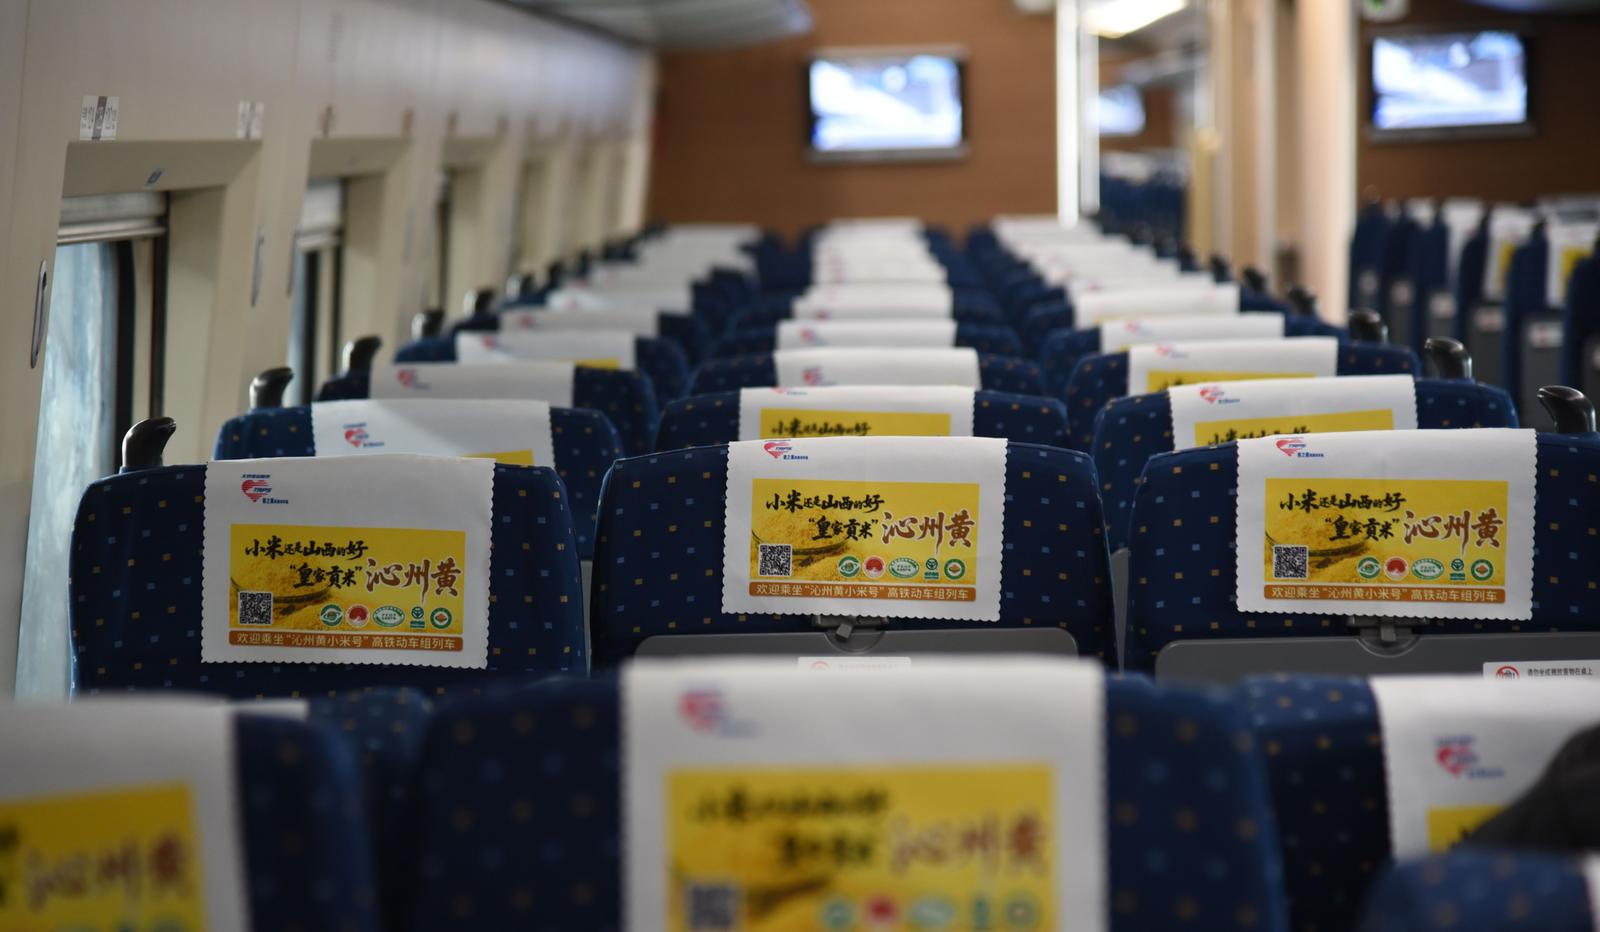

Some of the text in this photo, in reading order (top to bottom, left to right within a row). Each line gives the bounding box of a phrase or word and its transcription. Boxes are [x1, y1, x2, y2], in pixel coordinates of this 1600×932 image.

[766, 489, 884, 513] 小米还是山西的好
[1280, 489, 1406, 512] 小米还是山西的好
[245, 535, 368, 560] 小米还是山西的好
[882, 509, 975, 554] 沁州黄
[1404, 508, 1503, 554] 沁州黄
[366, 557, 461, 602] 沁州黄
